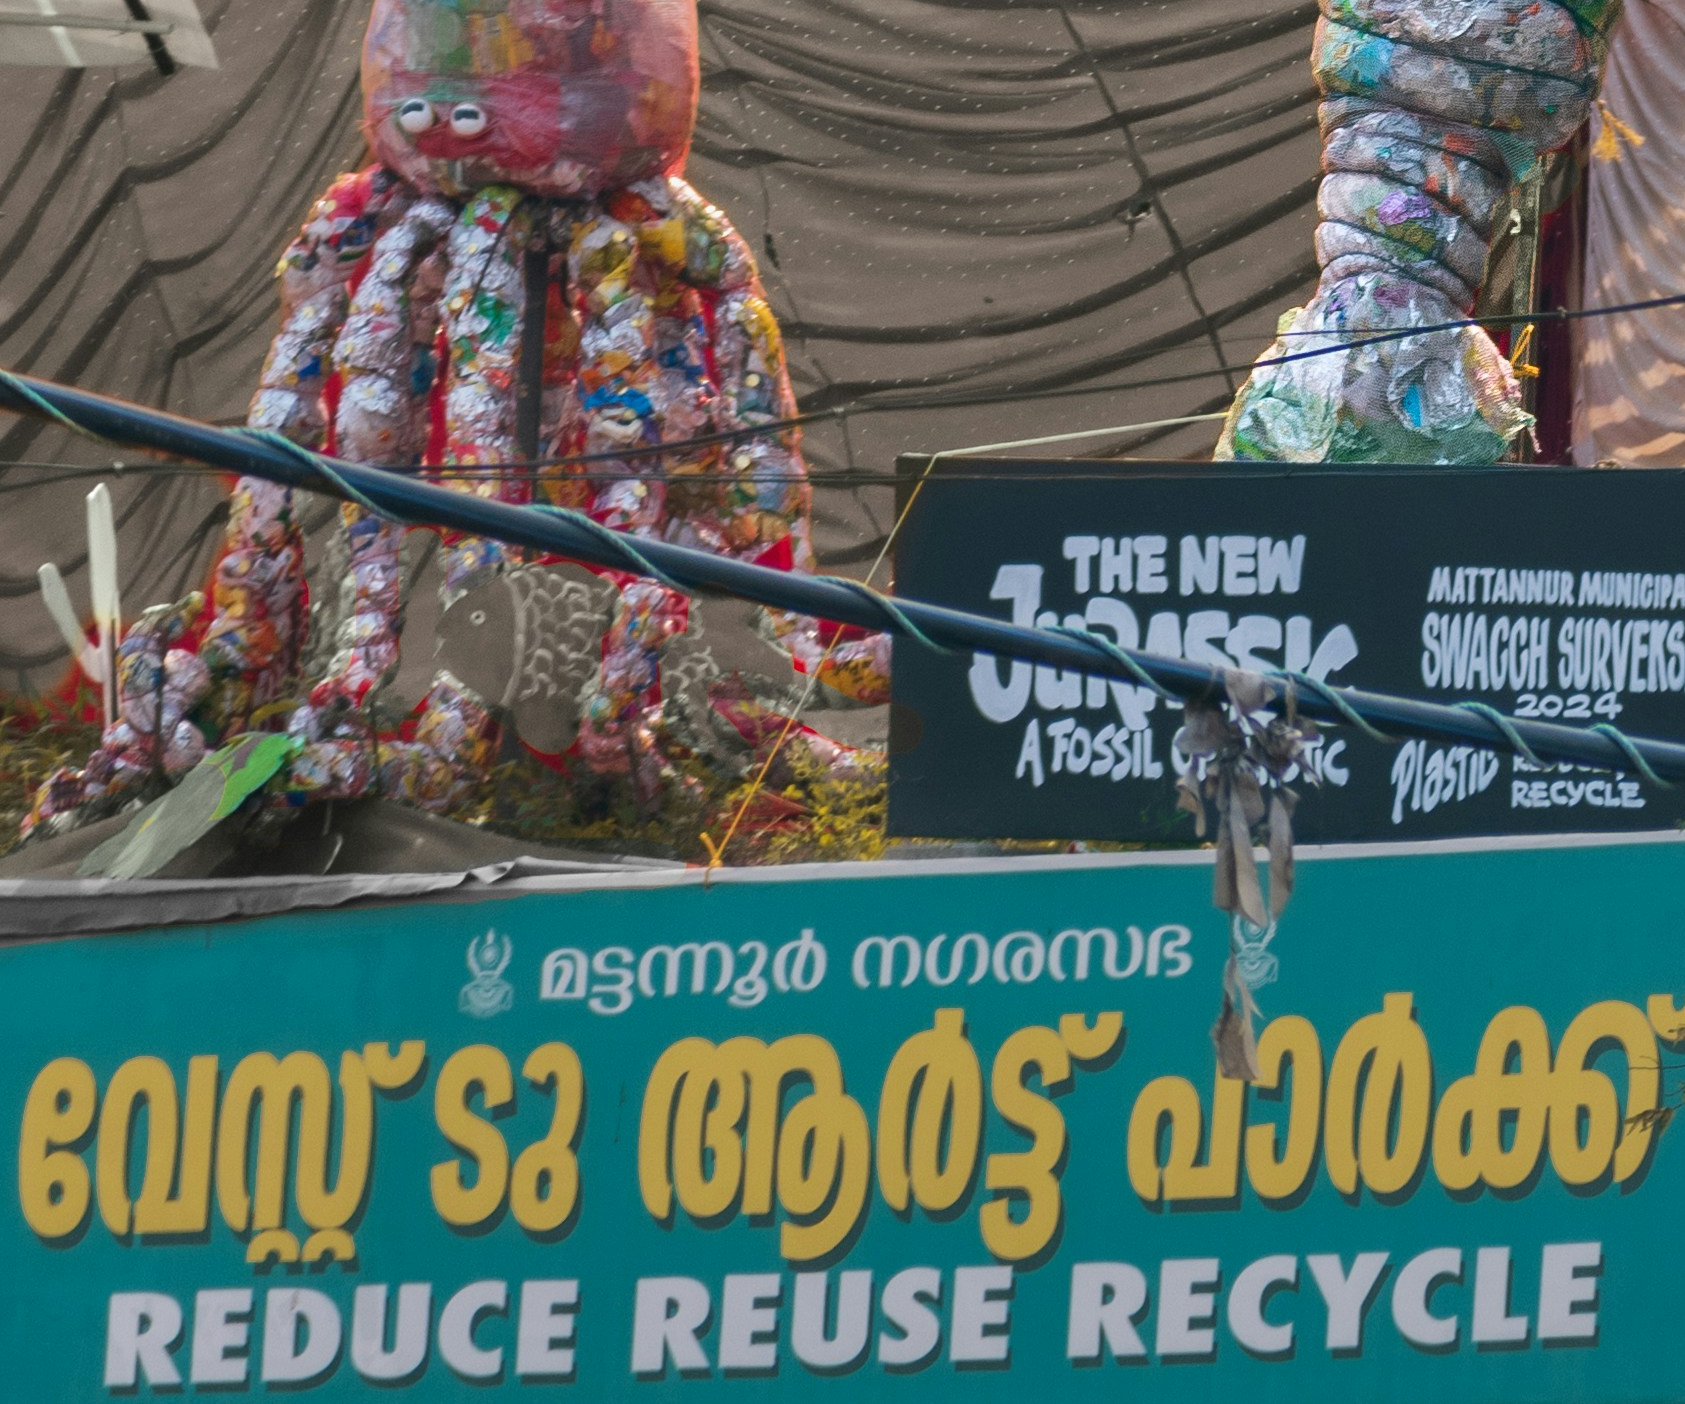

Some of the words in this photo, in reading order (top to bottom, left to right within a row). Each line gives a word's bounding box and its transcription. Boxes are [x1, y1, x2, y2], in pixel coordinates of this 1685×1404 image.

[1063, 535, 1169, 594] THE
[1179, 534, 1307, 596] NEW
[1426, 566, 1576, 606] MATTANNUR
[1421, 611, 1551, 690] SWACCH
[1513, 692, 1623, 719] 2024
[1015, 718, 1045, 788] A
[1047, 718, 1163, 782] FOSSIL
[1511, 780, 1647, 808] RECYCLE
[851, 924, 1193, 988] നഗരസഭ
[430, 1041, 584, 1232] ടു
[104, 1278, 580, 1388] REDUCE
[630, 1265, 1014, 1373] REUSE
[1066, 1241, 1602, 1359] RECYCLE
